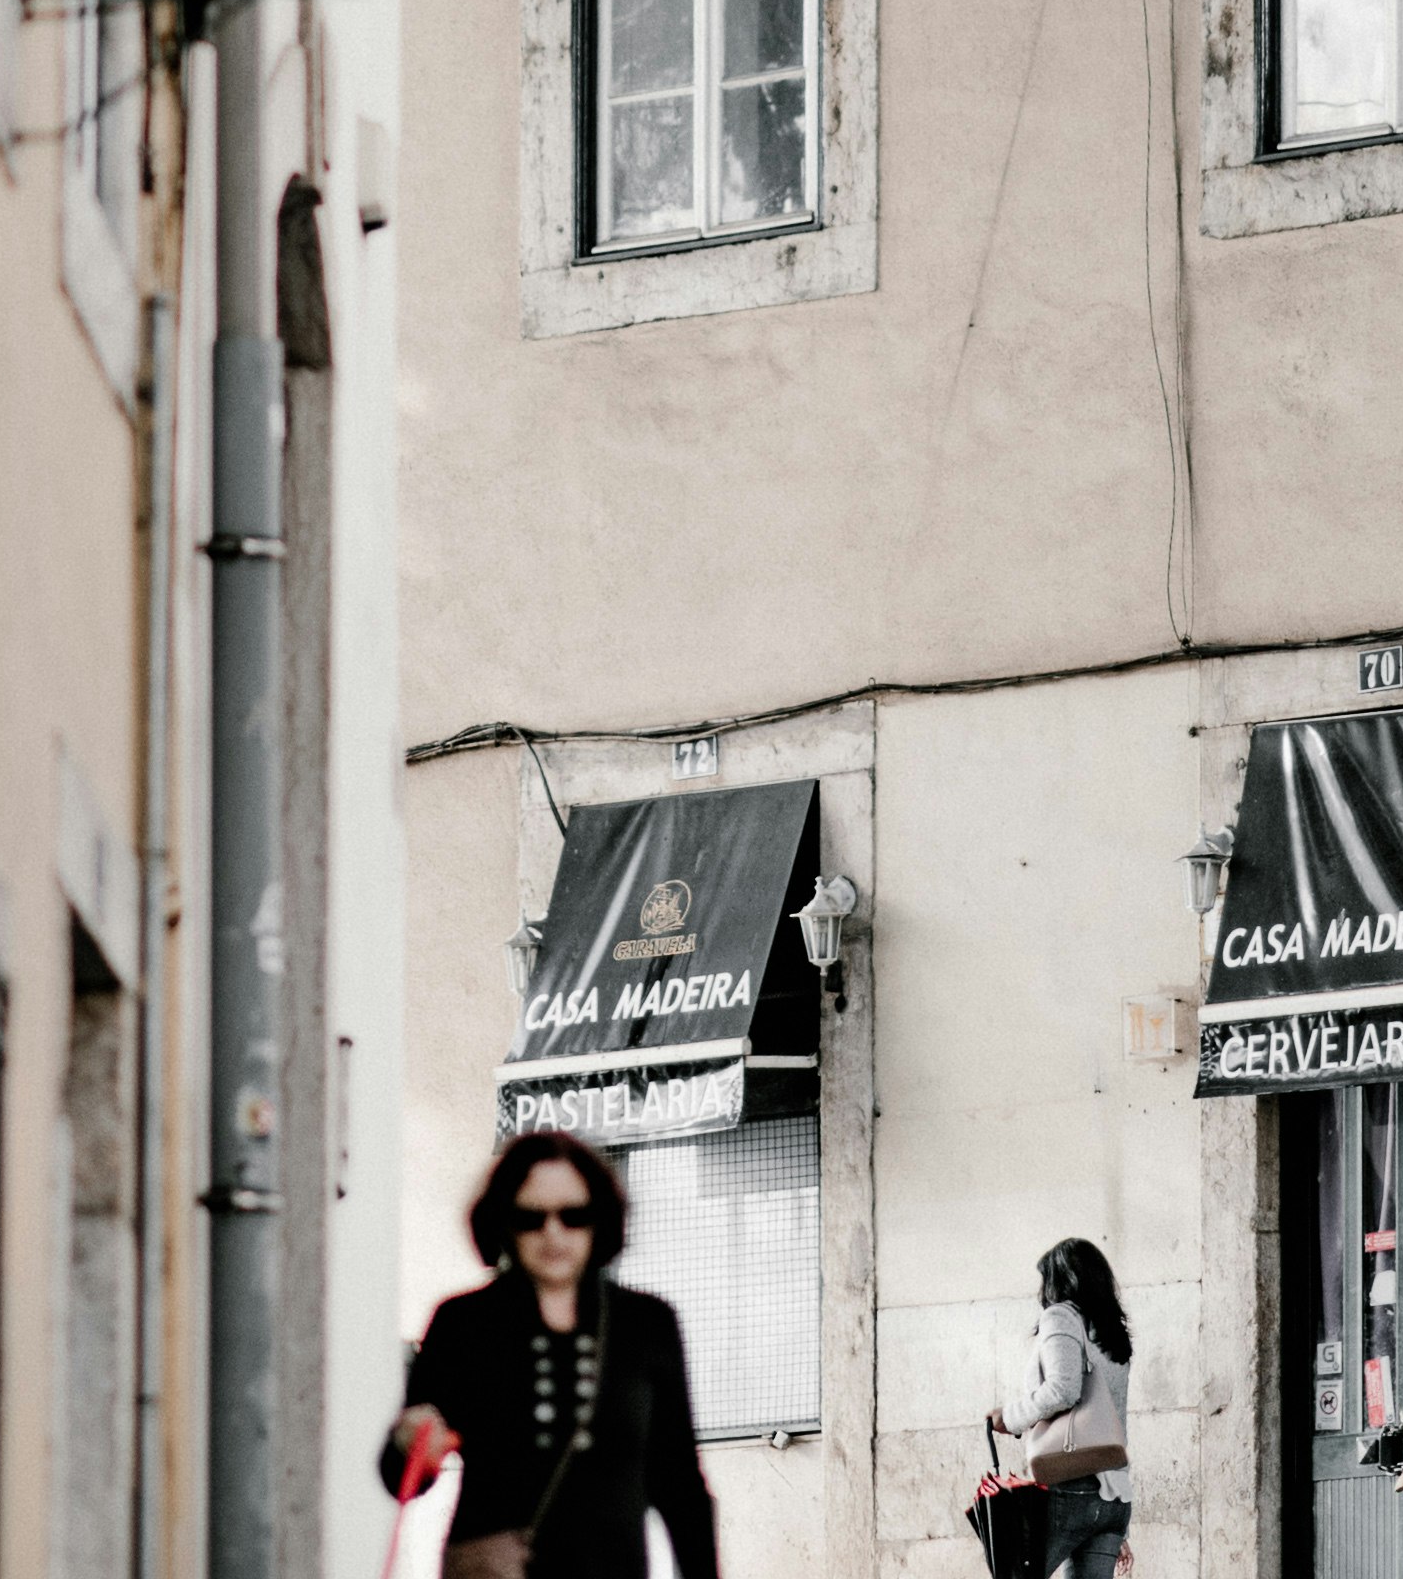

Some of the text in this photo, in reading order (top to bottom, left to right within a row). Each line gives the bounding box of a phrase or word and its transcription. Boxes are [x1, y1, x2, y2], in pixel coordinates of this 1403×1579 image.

[1364, 650, 1396, 689] 70
[679, 739, 710, 776] 72
[613, 932, 697, 961] CARAVELA
[1222, 922, 1305, 968] CASA
[524, 968, 751, 1031] CASA MADEIRA
[514, 1071, 728, 1136] PASTELARIA
